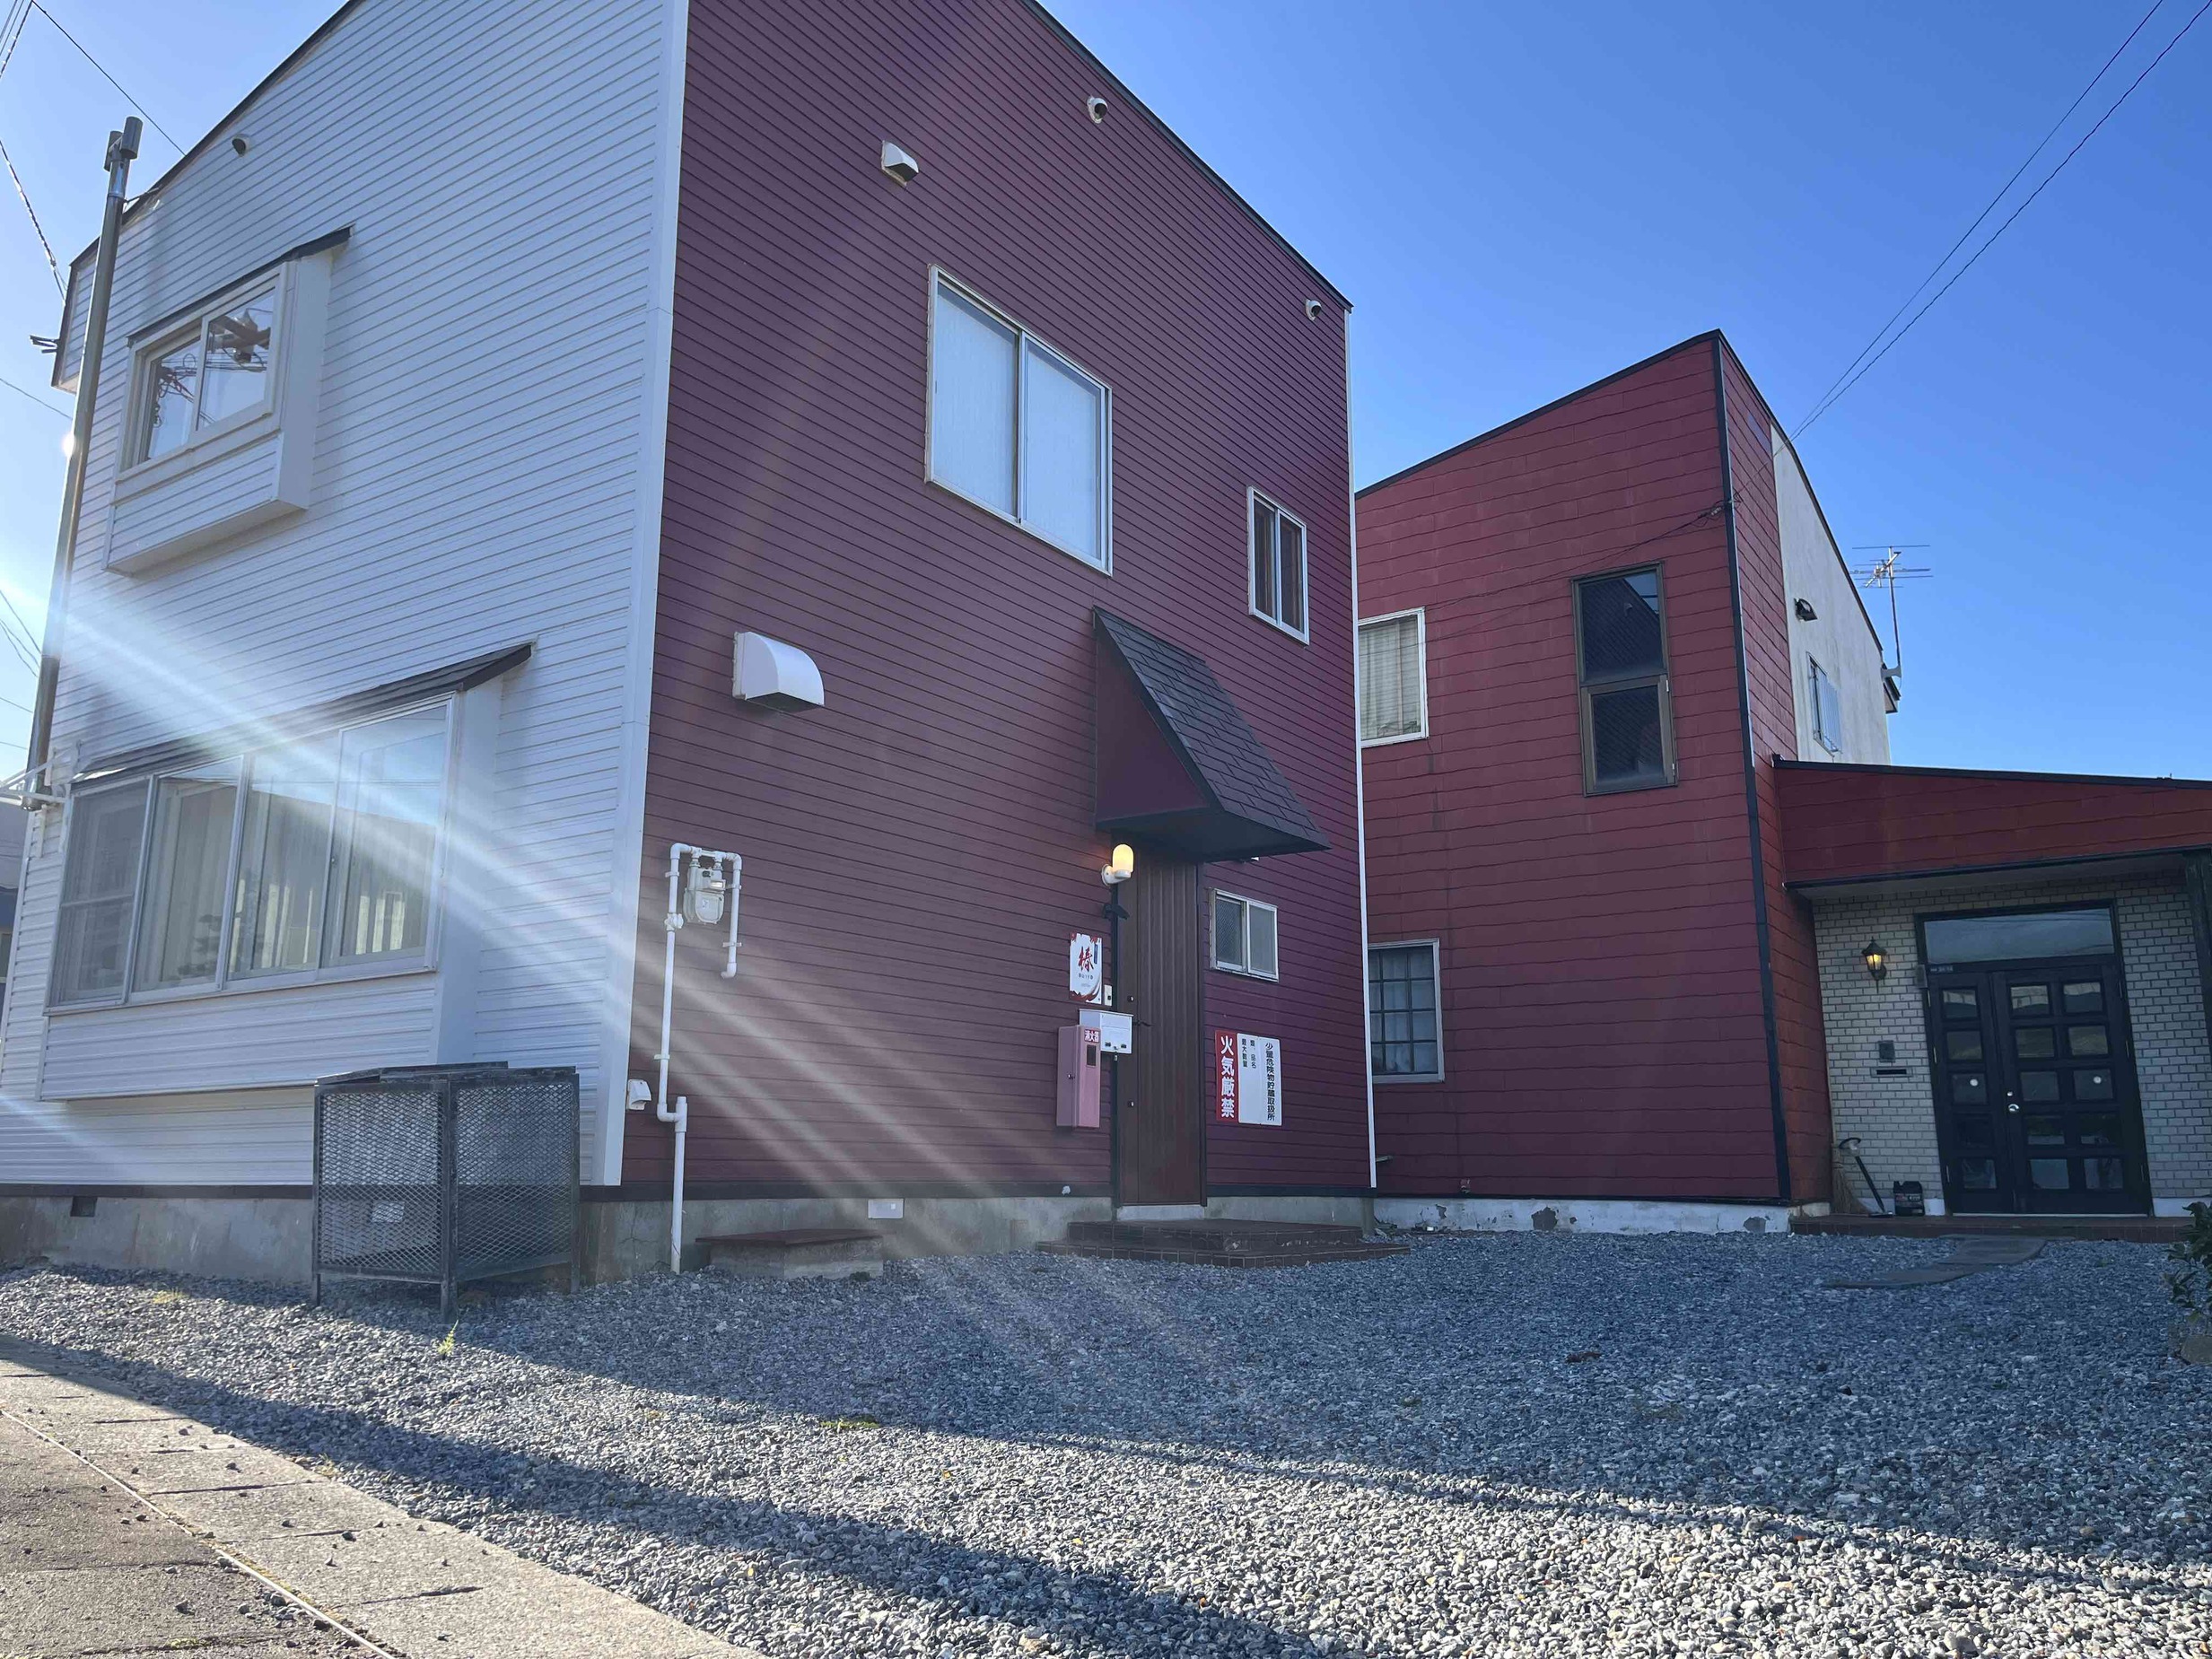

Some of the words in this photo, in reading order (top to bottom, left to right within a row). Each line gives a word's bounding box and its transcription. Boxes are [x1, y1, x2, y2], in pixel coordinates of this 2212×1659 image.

[1220, 1035, 1235, 1118] 火気厳禁
[1264, 1042, 1275, 1122] 少量危険物貯蔵取扱所
